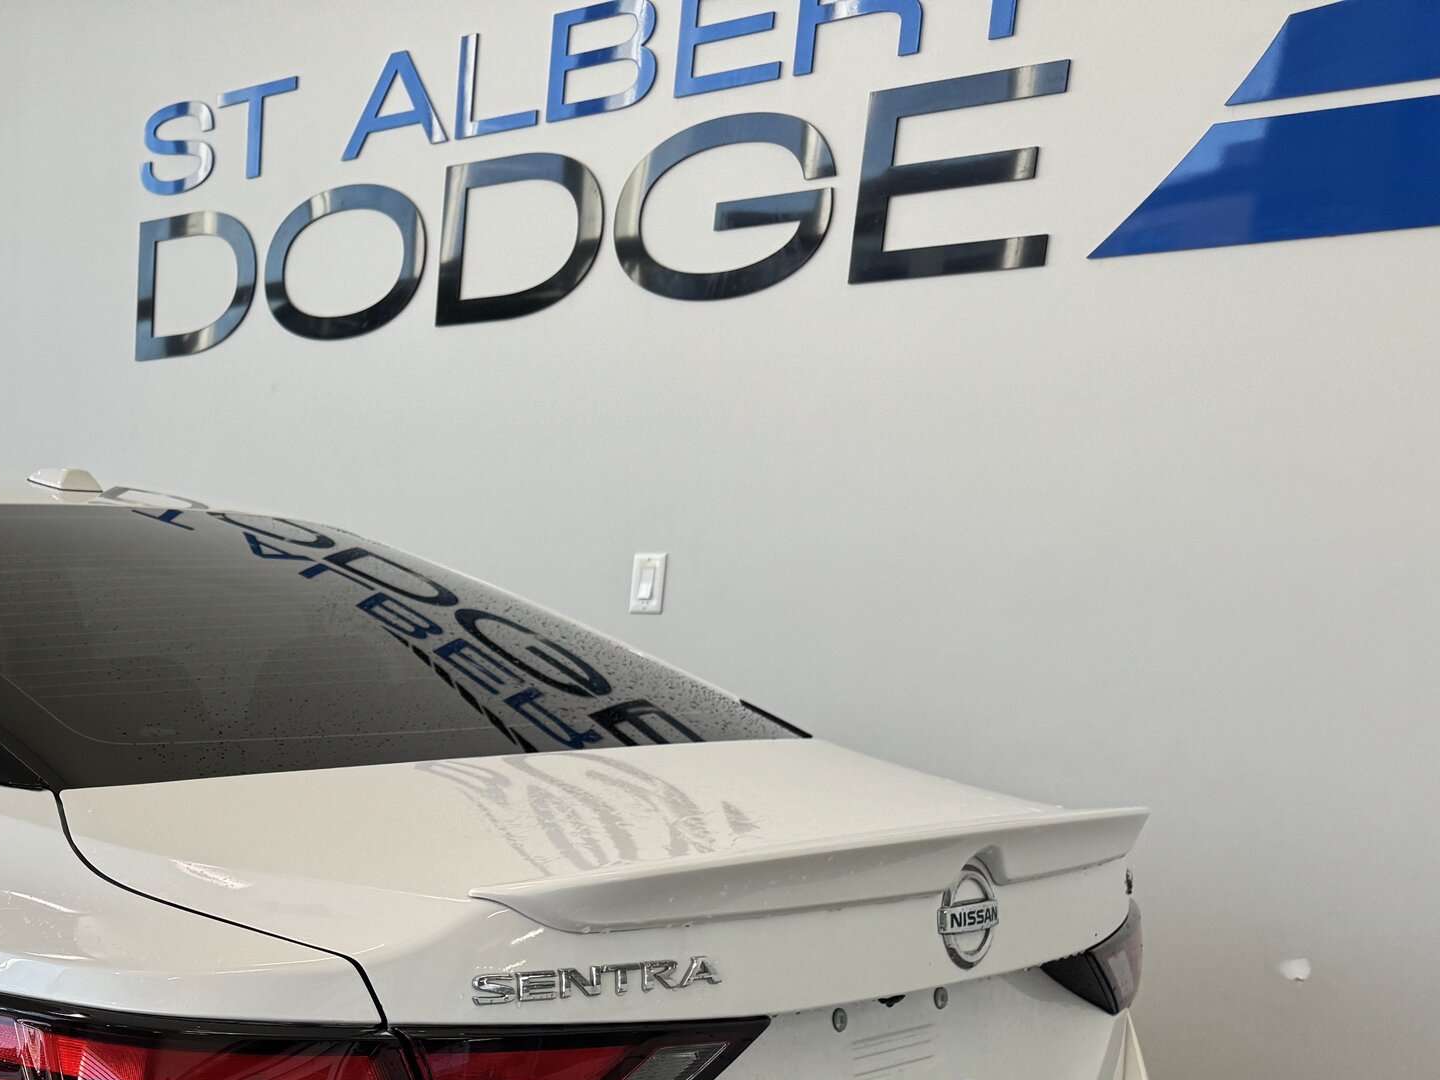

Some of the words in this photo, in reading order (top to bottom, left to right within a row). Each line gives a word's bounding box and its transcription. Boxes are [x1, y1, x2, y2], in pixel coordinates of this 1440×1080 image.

[140, 75, 299, 196] ST
[135, 58, 1071, 362] DODGE
[949, 905, 999, 930] NISSAN
[470, 954, 723, 1007] SENTRA
